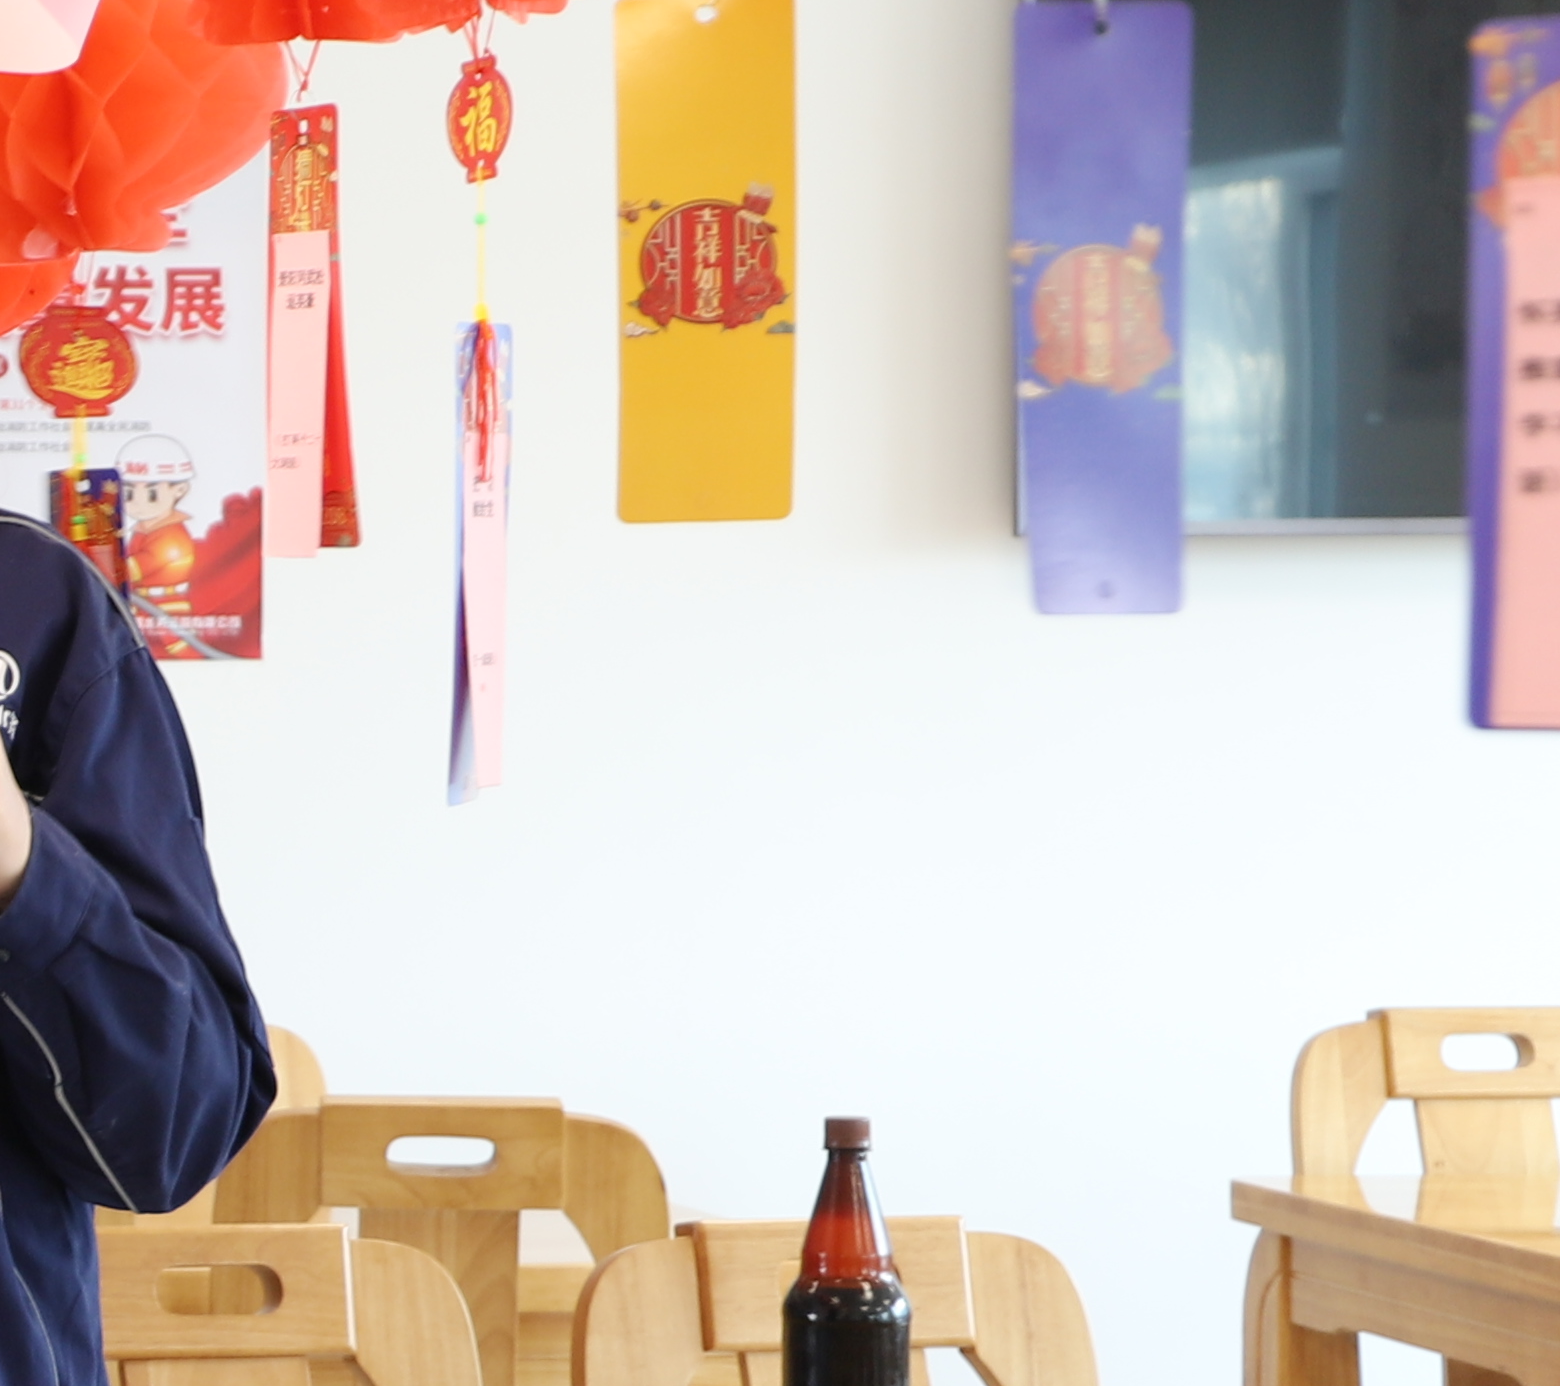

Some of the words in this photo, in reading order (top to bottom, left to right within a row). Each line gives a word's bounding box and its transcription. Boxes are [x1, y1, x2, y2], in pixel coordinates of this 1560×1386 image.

[459, 80, 498, 158] 福
[692, 206, 724, 318] 吉祥如意
